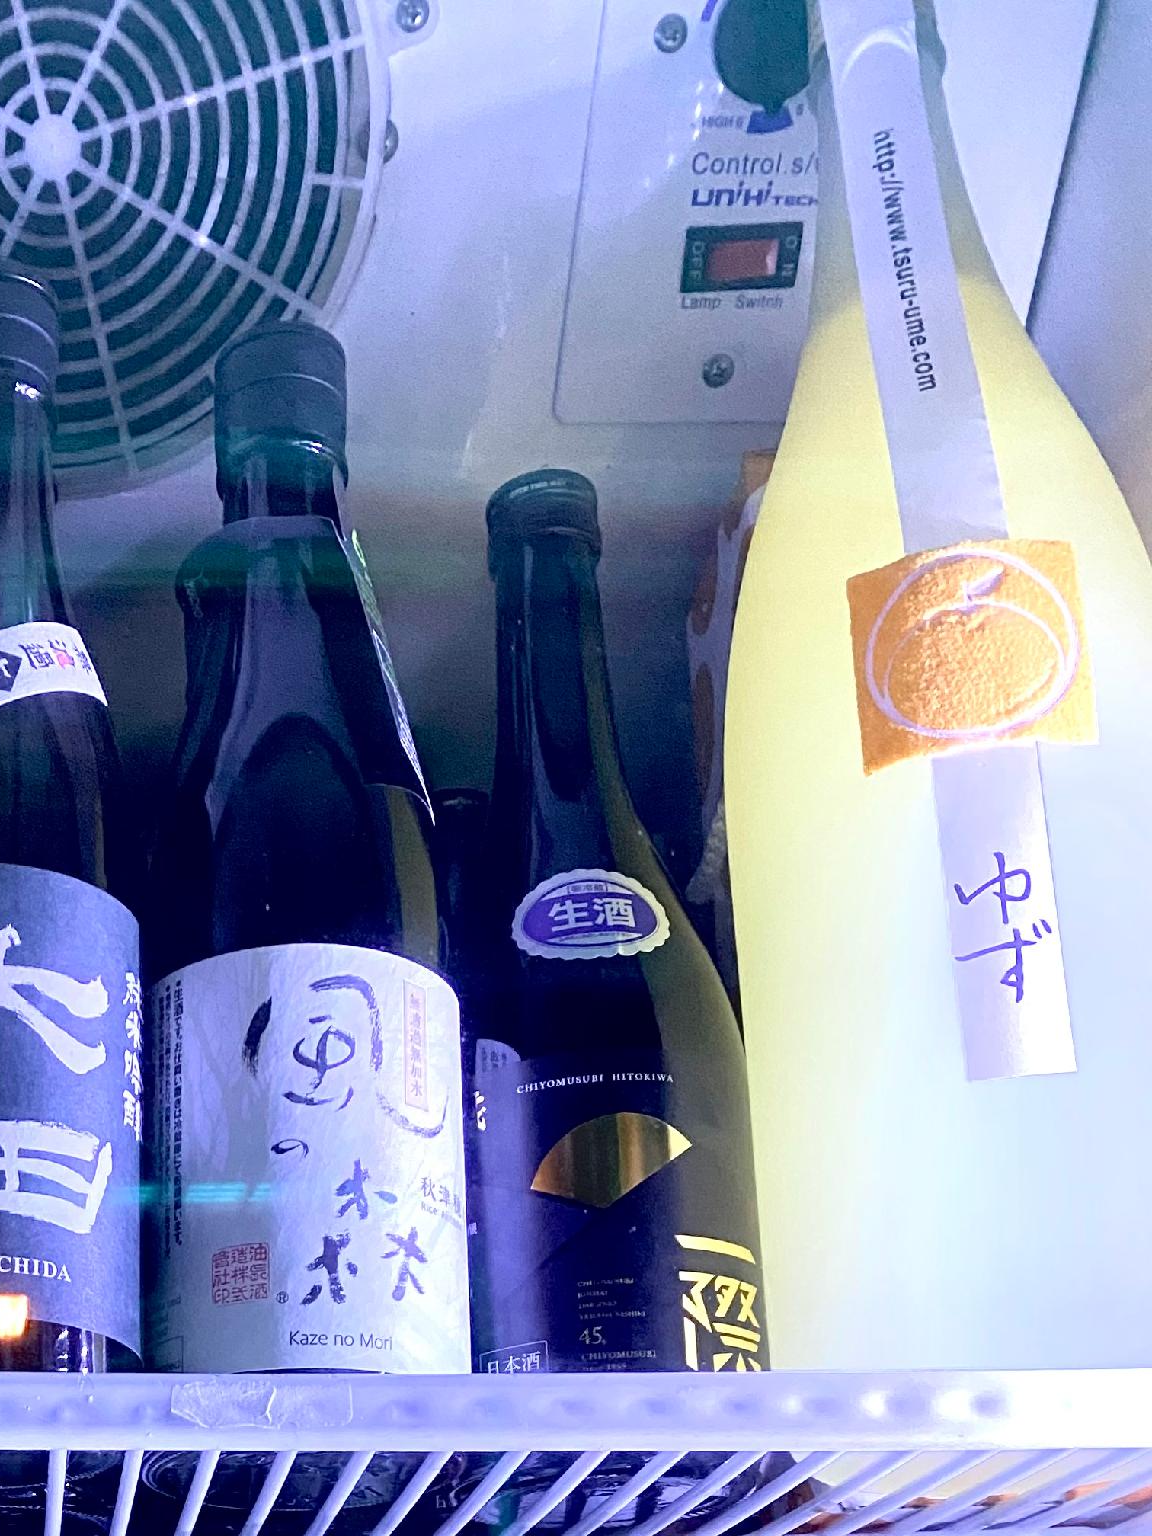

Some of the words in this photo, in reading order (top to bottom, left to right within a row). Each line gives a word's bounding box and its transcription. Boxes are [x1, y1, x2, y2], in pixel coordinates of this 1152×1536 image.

[872, 127, 938, 393] http://www.tsuru-ume.com
[681, 295, 722, 310] Lamp
[734, 294, 784, 309] Switch
[548, 897, 636, 932] 生酒
[954, 851, 1053, 1004] ゆず
[516, 1073, 605, 1094] CHIYOMUSUBI
[288, 1329, 329, 1347] Kaze
[333, 1334, 356, 1348] no
[359, 1332, 394, 1351] Mori
[487, 1351, 541, 1374] 日本酒
